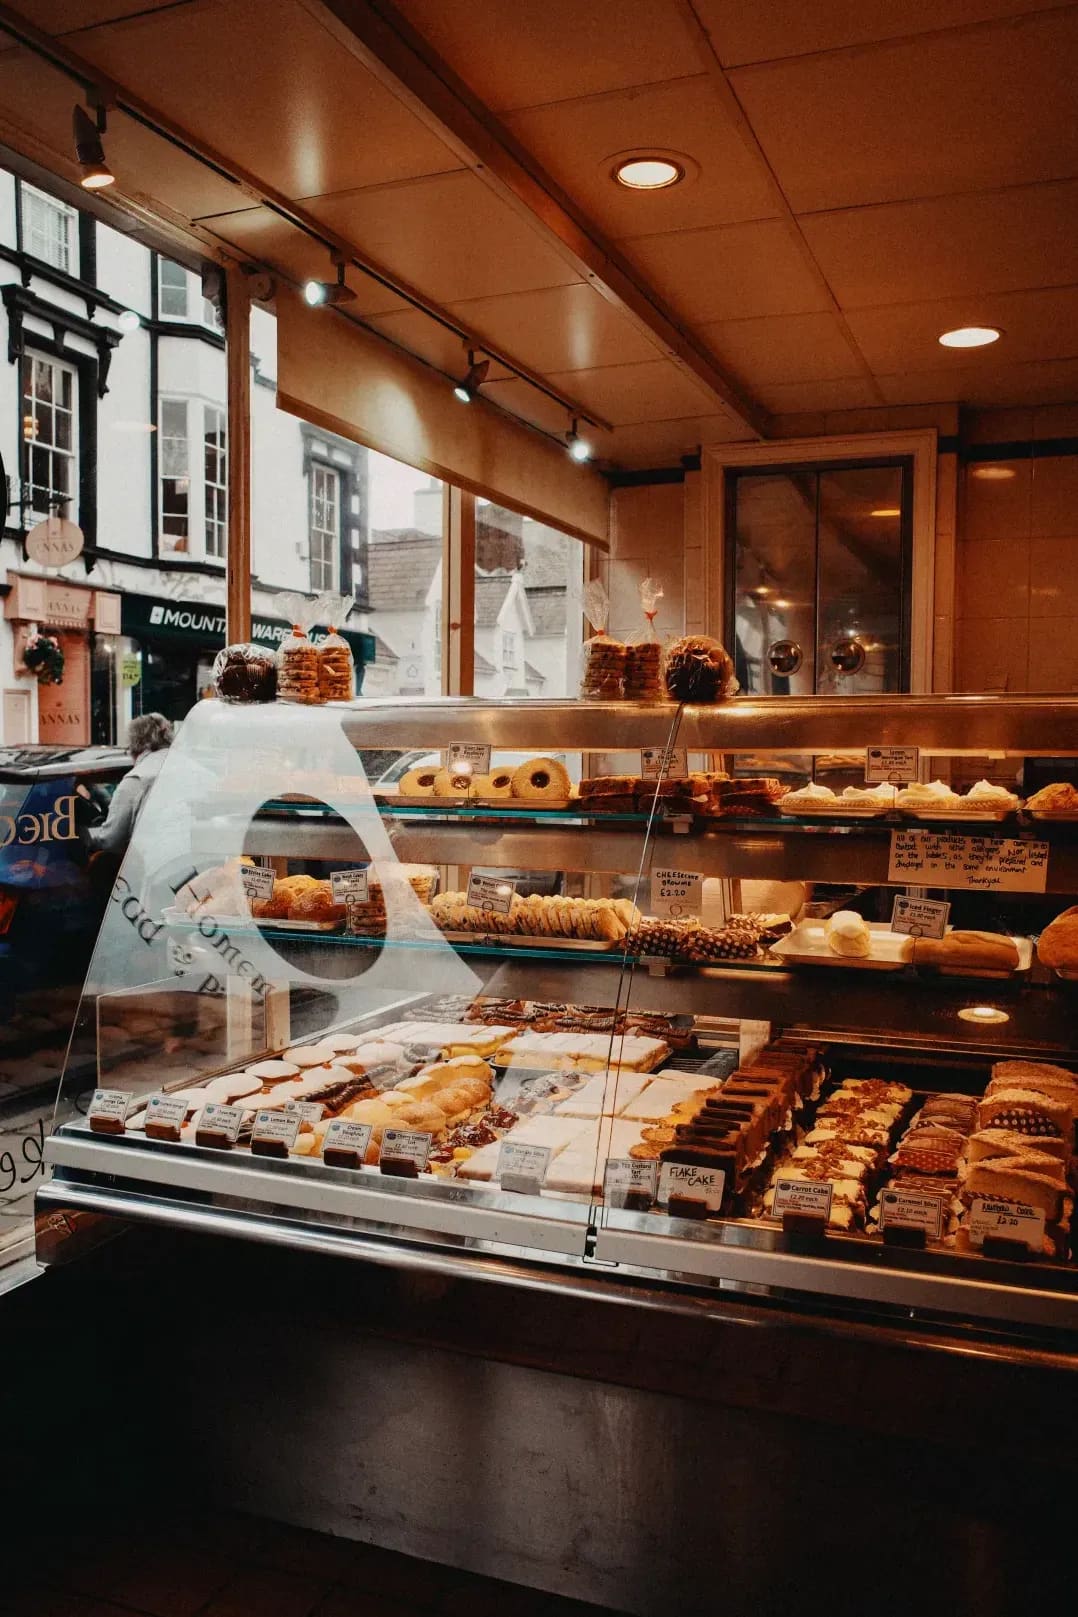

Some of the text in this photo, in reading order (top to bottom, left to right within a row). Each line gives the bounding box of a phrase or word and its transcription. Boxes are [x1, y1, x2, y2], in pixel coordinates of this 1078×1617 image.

[660, 888, 686, 897] £2.20
[687, 1174, 716, 1187] CAKE
[791, 1184, 829, 1195] Carrot Cake
